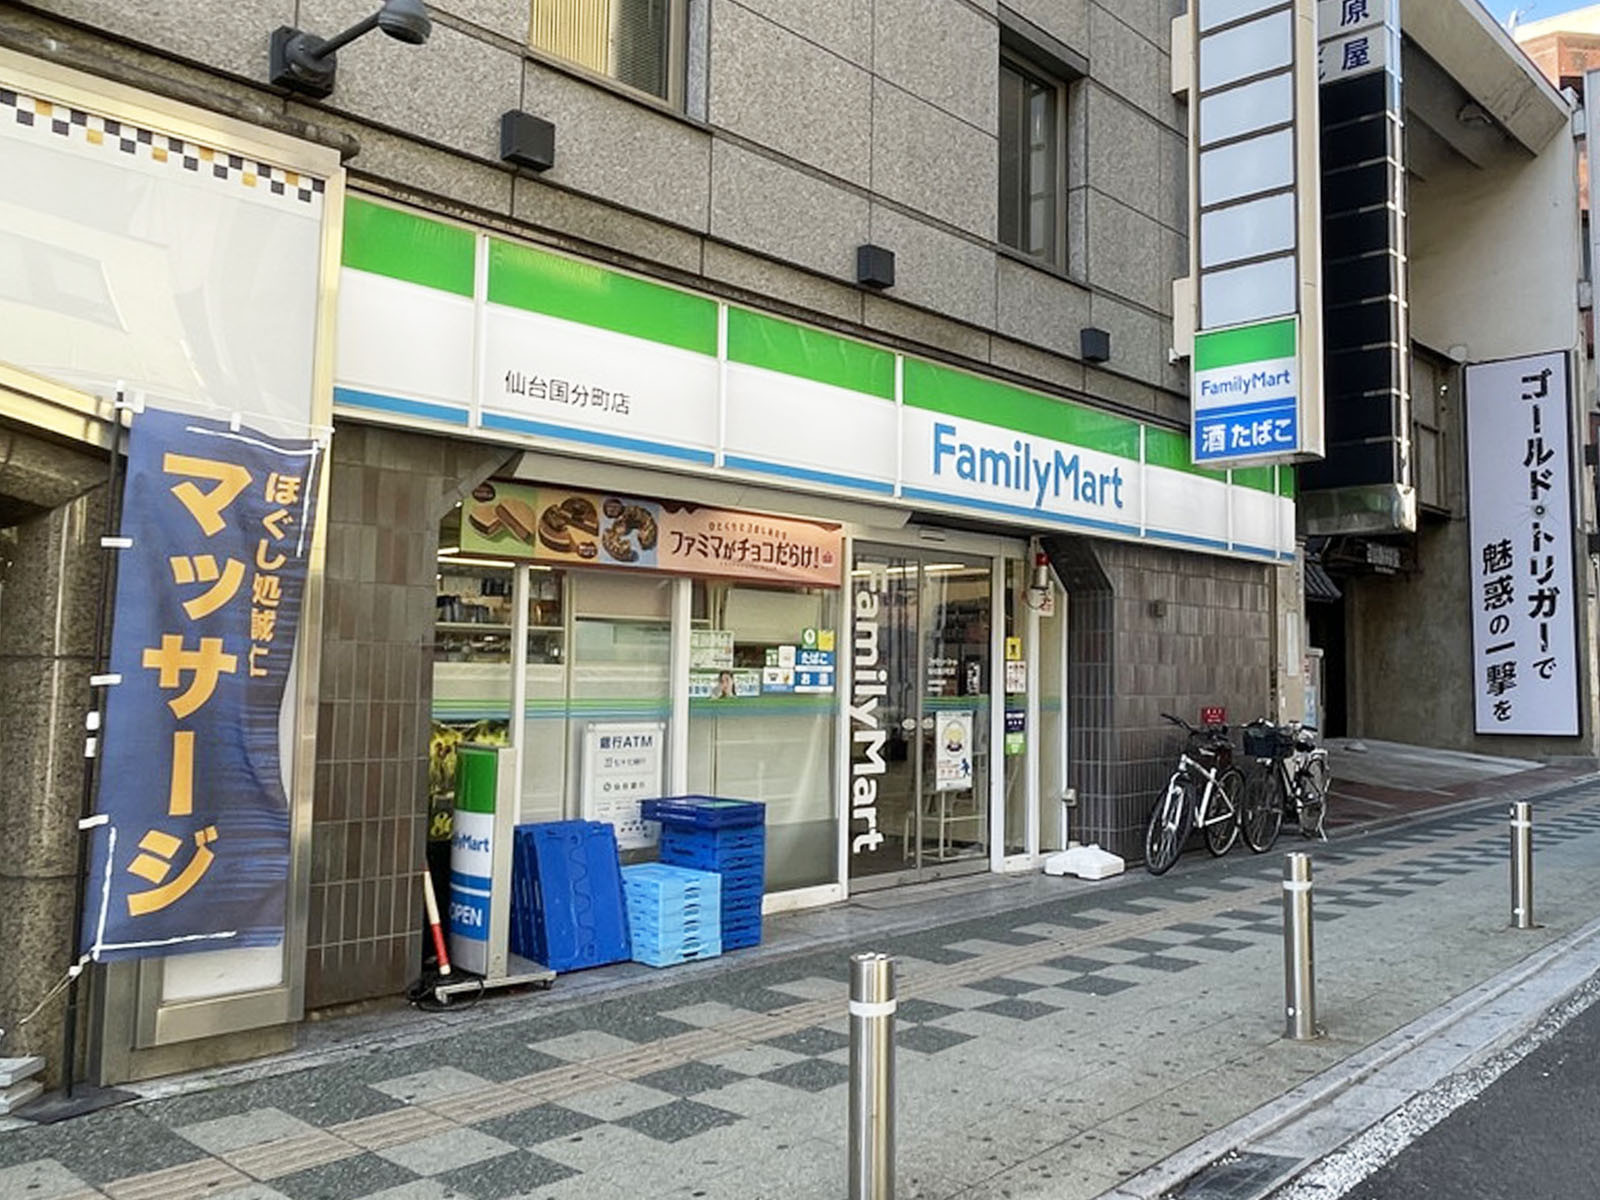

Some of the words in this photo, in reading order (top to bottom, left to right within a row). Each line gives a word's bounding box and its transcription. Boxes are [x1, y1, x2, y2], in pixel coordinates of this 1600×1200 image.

[505, 370, 631, 415] 仙台国分町店
[1202, 370, 1290, 396] FamilyMart
[933, 422, 1123, 509] FamilyMart
[1202, 424, 1226, 452] 酒
[1231, 419, 1293, 448] たばこ
[670, 531, 820, 569] ファミマがチョコだらけ!
[1483, 538, 1517, 722] 魅惑の一撃を
[127, 452, 252, 916] マッサージ
[850, 562, 888, 854] FamilyMart
